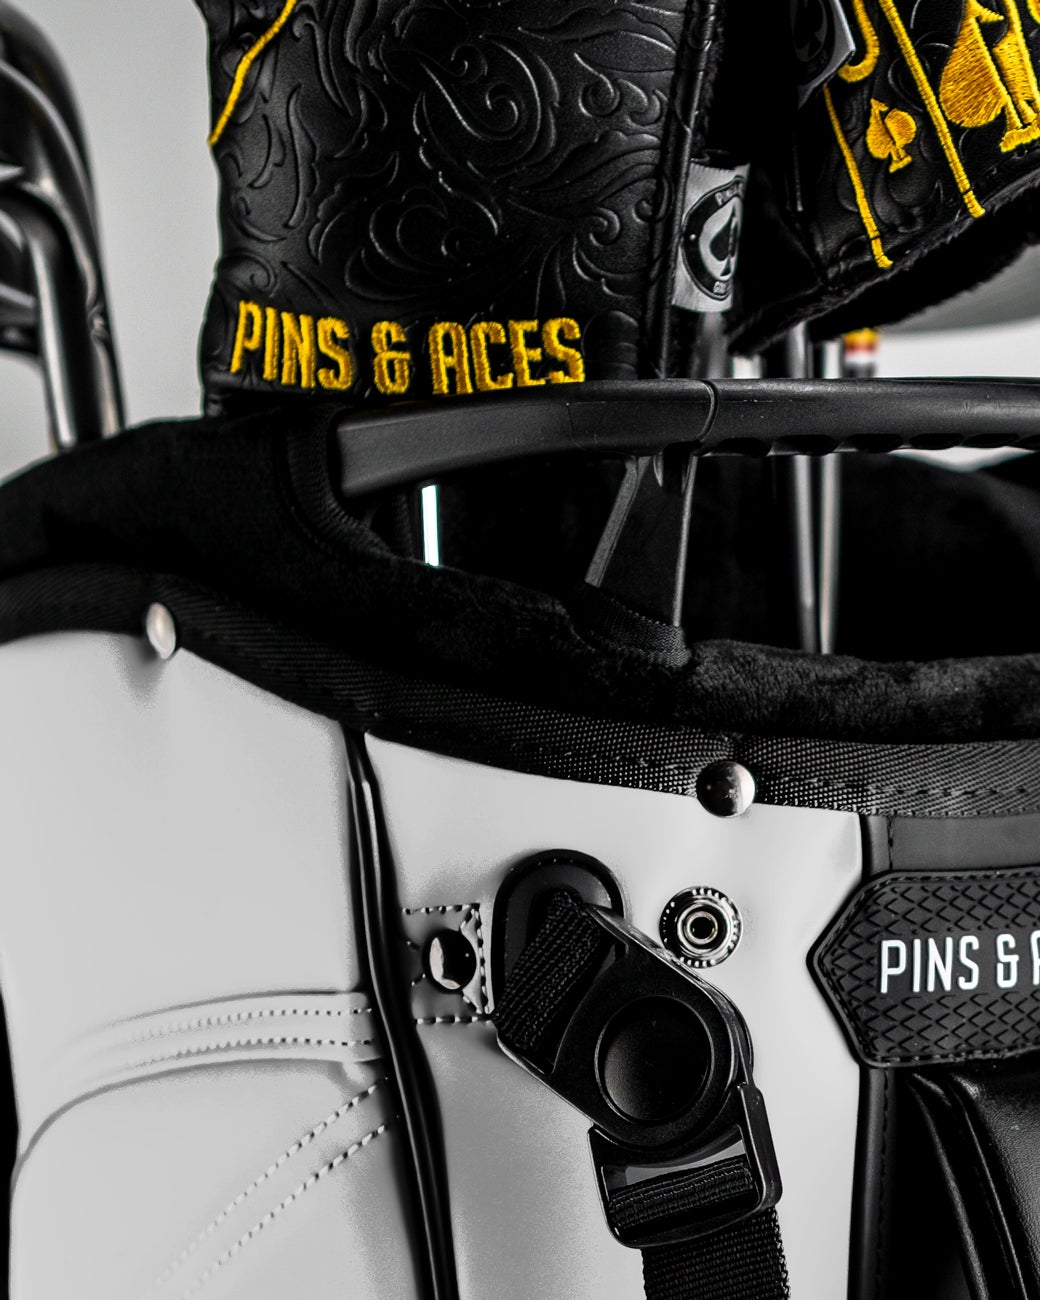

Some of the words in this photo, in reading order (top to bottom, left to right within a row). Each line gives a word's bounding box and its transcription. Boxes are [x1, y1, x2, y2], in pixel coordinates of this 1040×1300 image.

[230, 300, 353, 390] PINS
[371, 320, 411, 394] &
[429, 317, 586, 395] ACES
[880, 935, 980, 994] PINS
[996, 933, 1020, 989] &
